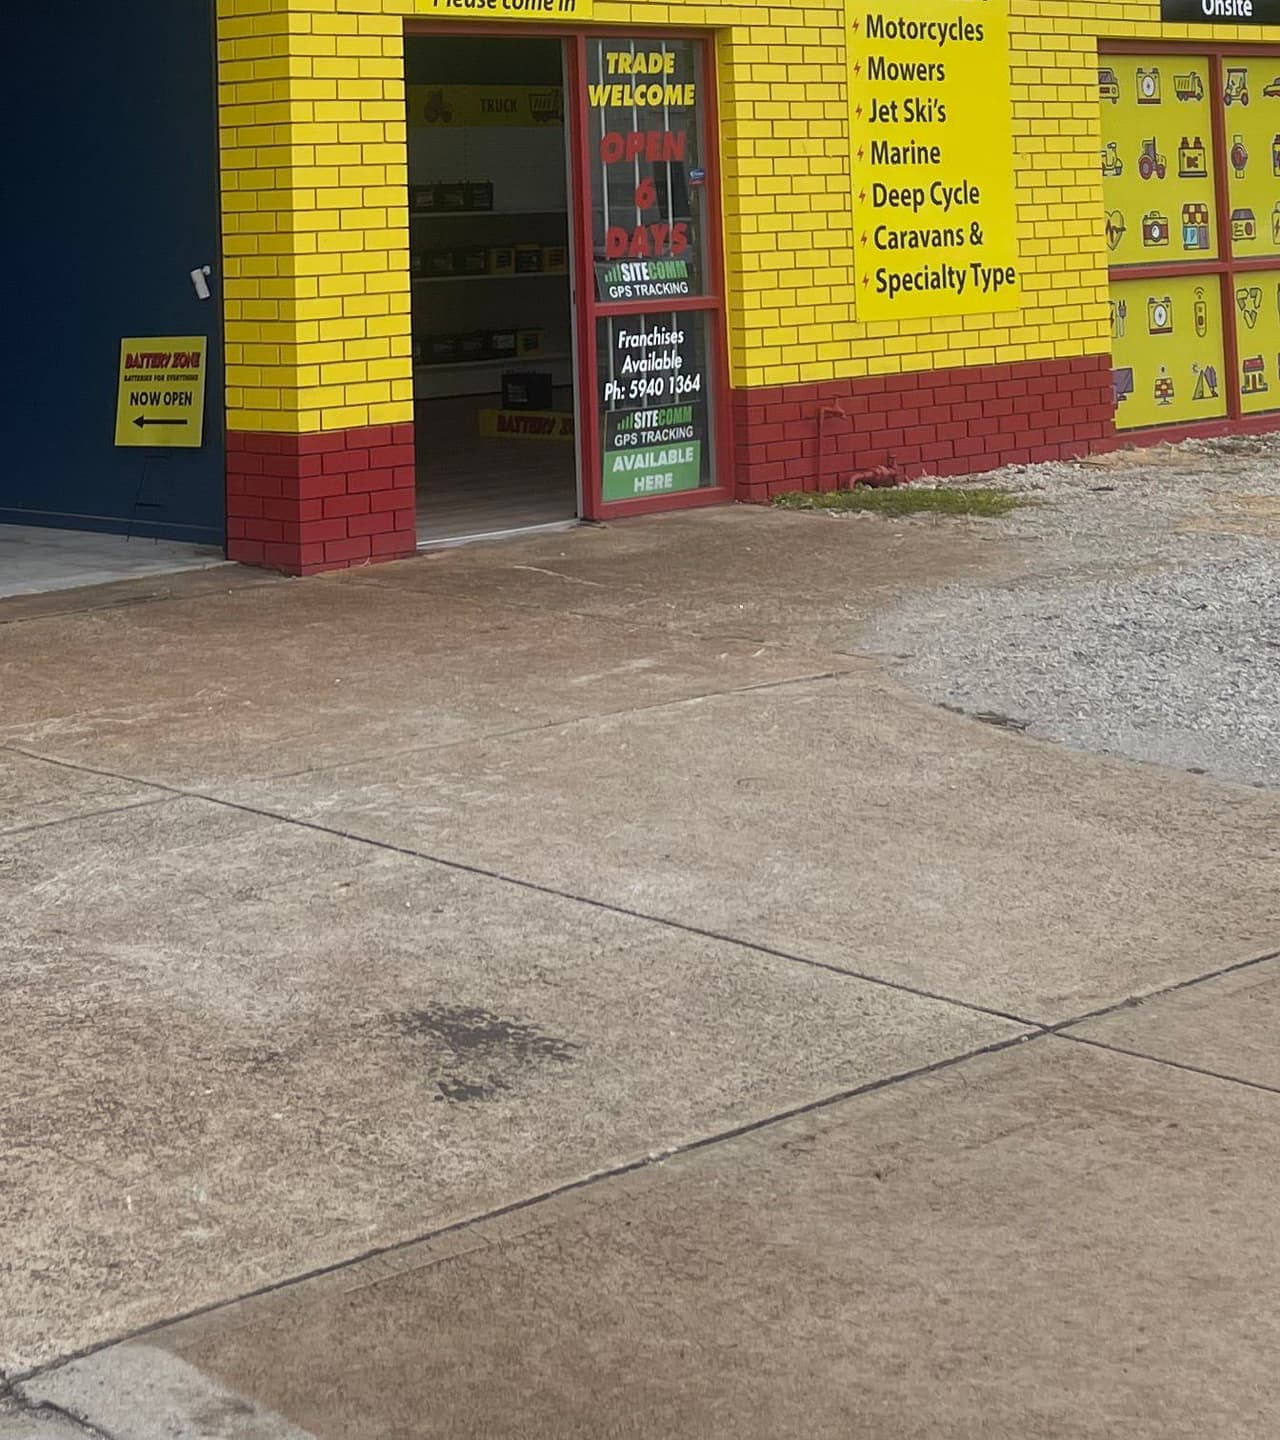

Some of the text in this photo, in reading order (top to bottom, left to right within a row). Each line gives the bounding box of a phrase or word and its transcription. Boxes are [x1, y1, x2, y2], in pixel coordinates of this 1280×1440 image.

[866, 14, 984, 47] Motorcycles
[606, 52, 675, 74] TRADE
[868, 56, 945, 82] Mowers
[480, 97, 519, 112] TRUCK
[588, 84, 696, 107] WELCOME
[868, 97, 946, 123] Jet Ski's
[600, 130, 686, 164] OPEN
[871, 139, 941, 165] Marine
[635, 177, 657, 209] 6
[872, 179, 980, 213] Deep Cycle
[606, 223, 689, 260] DAYS
[874, 221, 983, 250] Caravans &
[621, 260, 688, 282] SITECOMM
[875, 262, 1016, 299] Specialty Type
[609, 281, 688, 298] GPS TRACKING
[618, 325, 684, 349] Franchises
[125, 351, 201, 369] BATTERY ZONE
[621, 349, 682, 374] Available
[130, 391, 192, 406] NOW OPEN
[604, 374, 700, 401] Ph: 5940 1364
[634, 406, 693, 430] SITECOMM
[614, 425, 693, 447] GPS TRACKING
[612, 447, 694, 472] AVAILABLE
[634, 473, 672, 492] HERE
